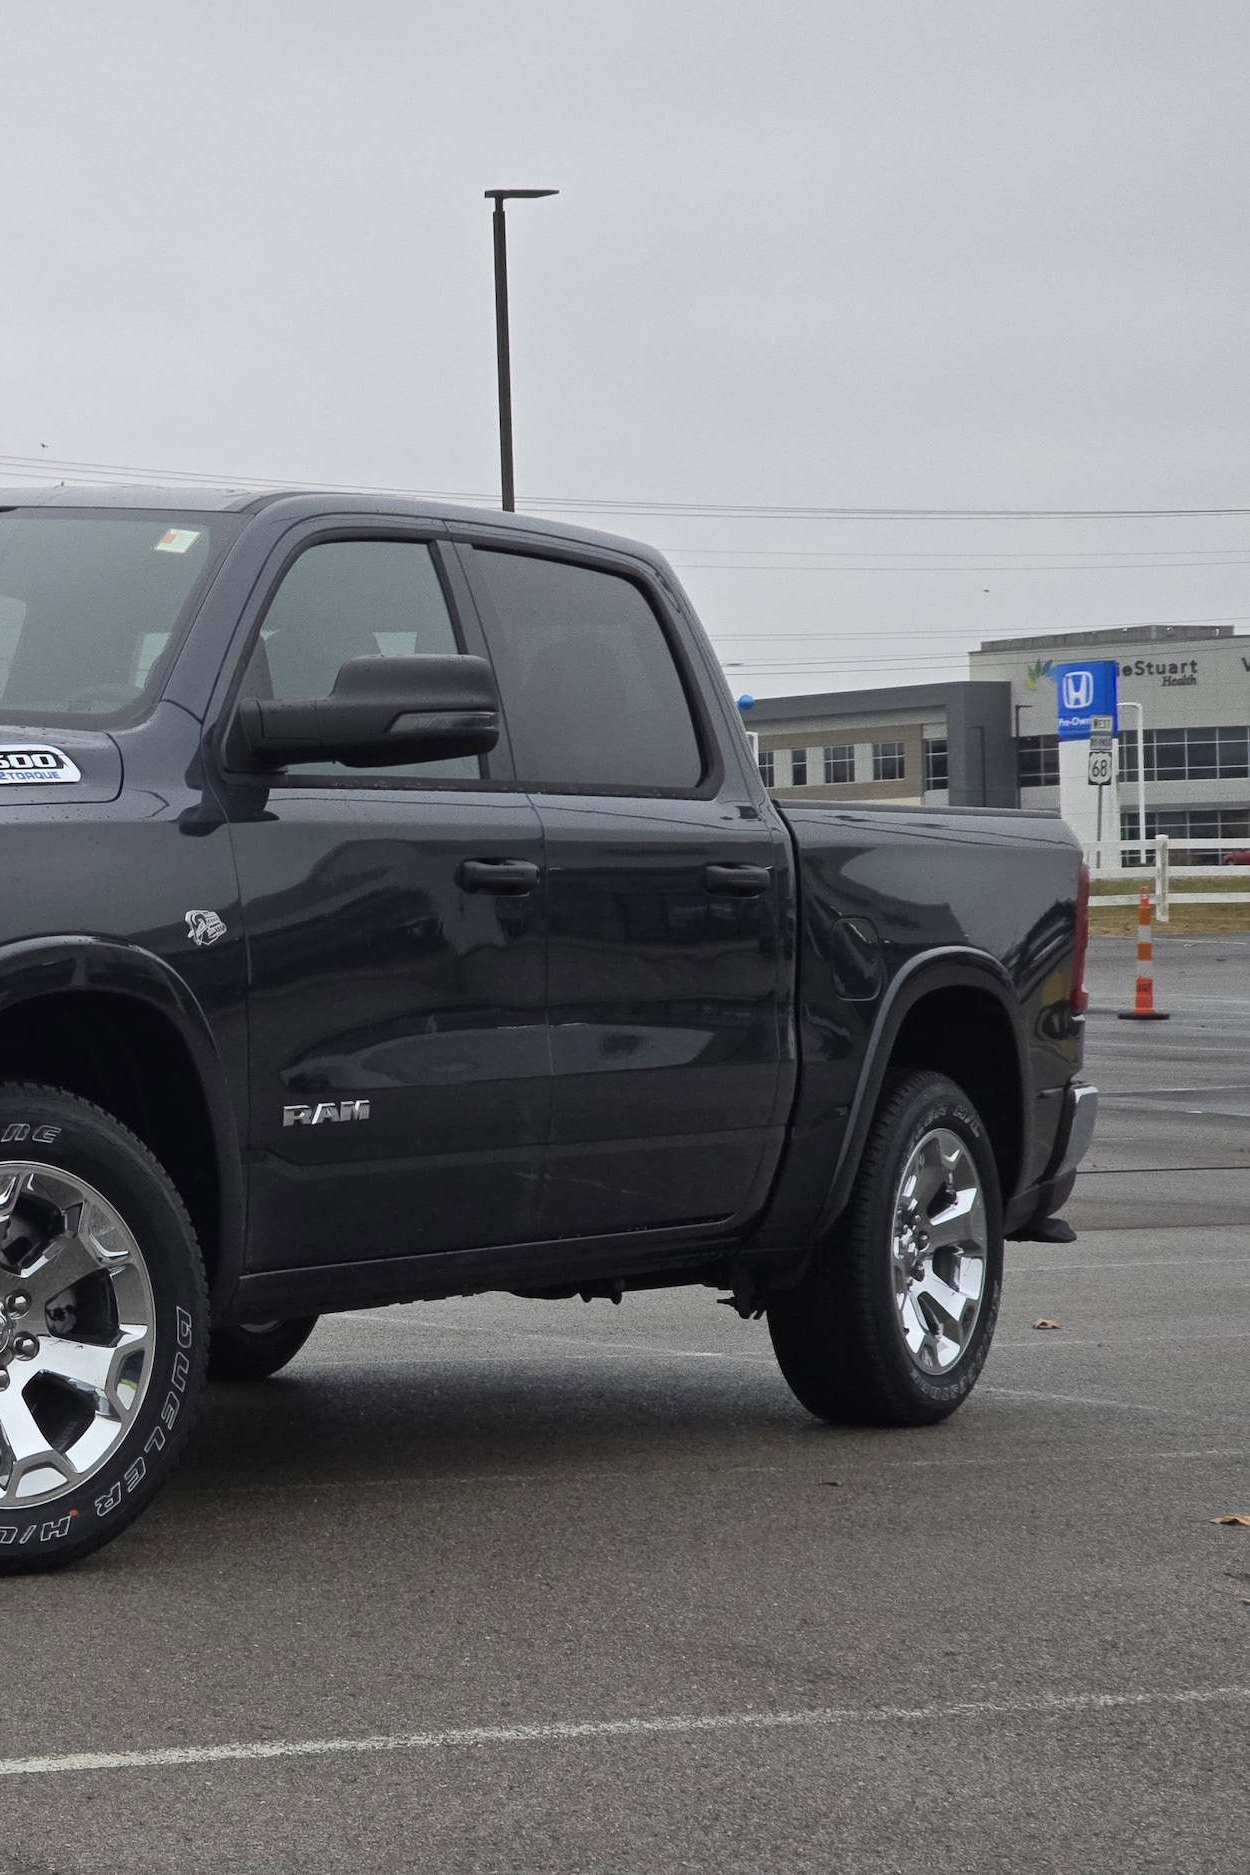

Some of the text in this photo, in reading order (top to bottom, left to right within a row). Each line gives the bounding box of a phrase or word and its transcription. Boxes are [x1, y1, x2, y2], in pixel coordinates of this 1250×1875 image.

[1161, 675, 1197, 687] Health
[1093, 718, 1111, 729] WEST
[1093, 759, 1107, 777] 68
[283, 1099, 370, 1128] RAM
[94, 1305, 192, 1518] DUELER
